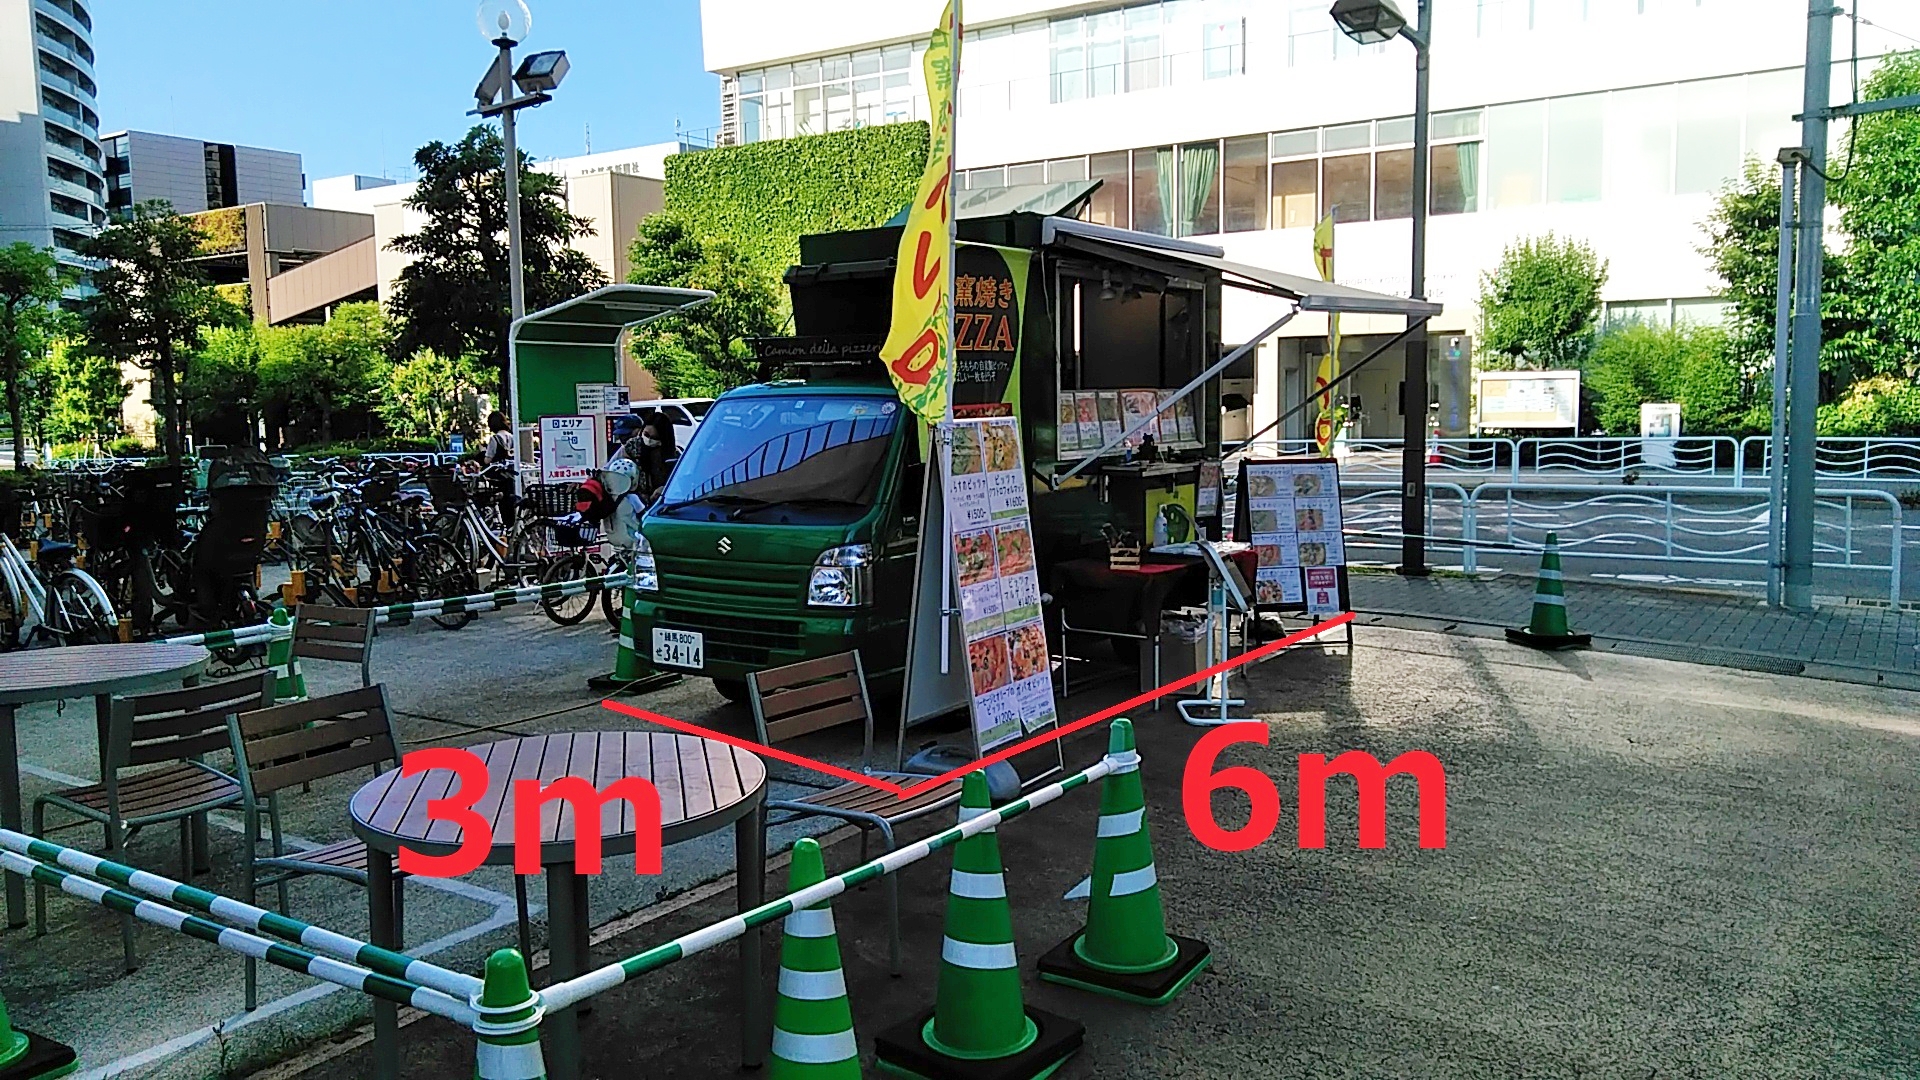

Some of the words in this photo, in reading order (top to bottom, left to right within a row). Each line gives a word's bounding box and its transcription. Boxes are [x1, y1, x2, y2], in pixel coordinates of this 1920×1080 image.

[956, 313, 1014, 351] ZZA
[764, 345, 806, 356] Camion
[809, 340, 837, 354] della
[841, 345, 881, 357] pizzeri
[561, 419, 583, 427] エリア
[951, 478, 986, 493] らすのピッツァ
[663, 643, 701, 666] 34-14
